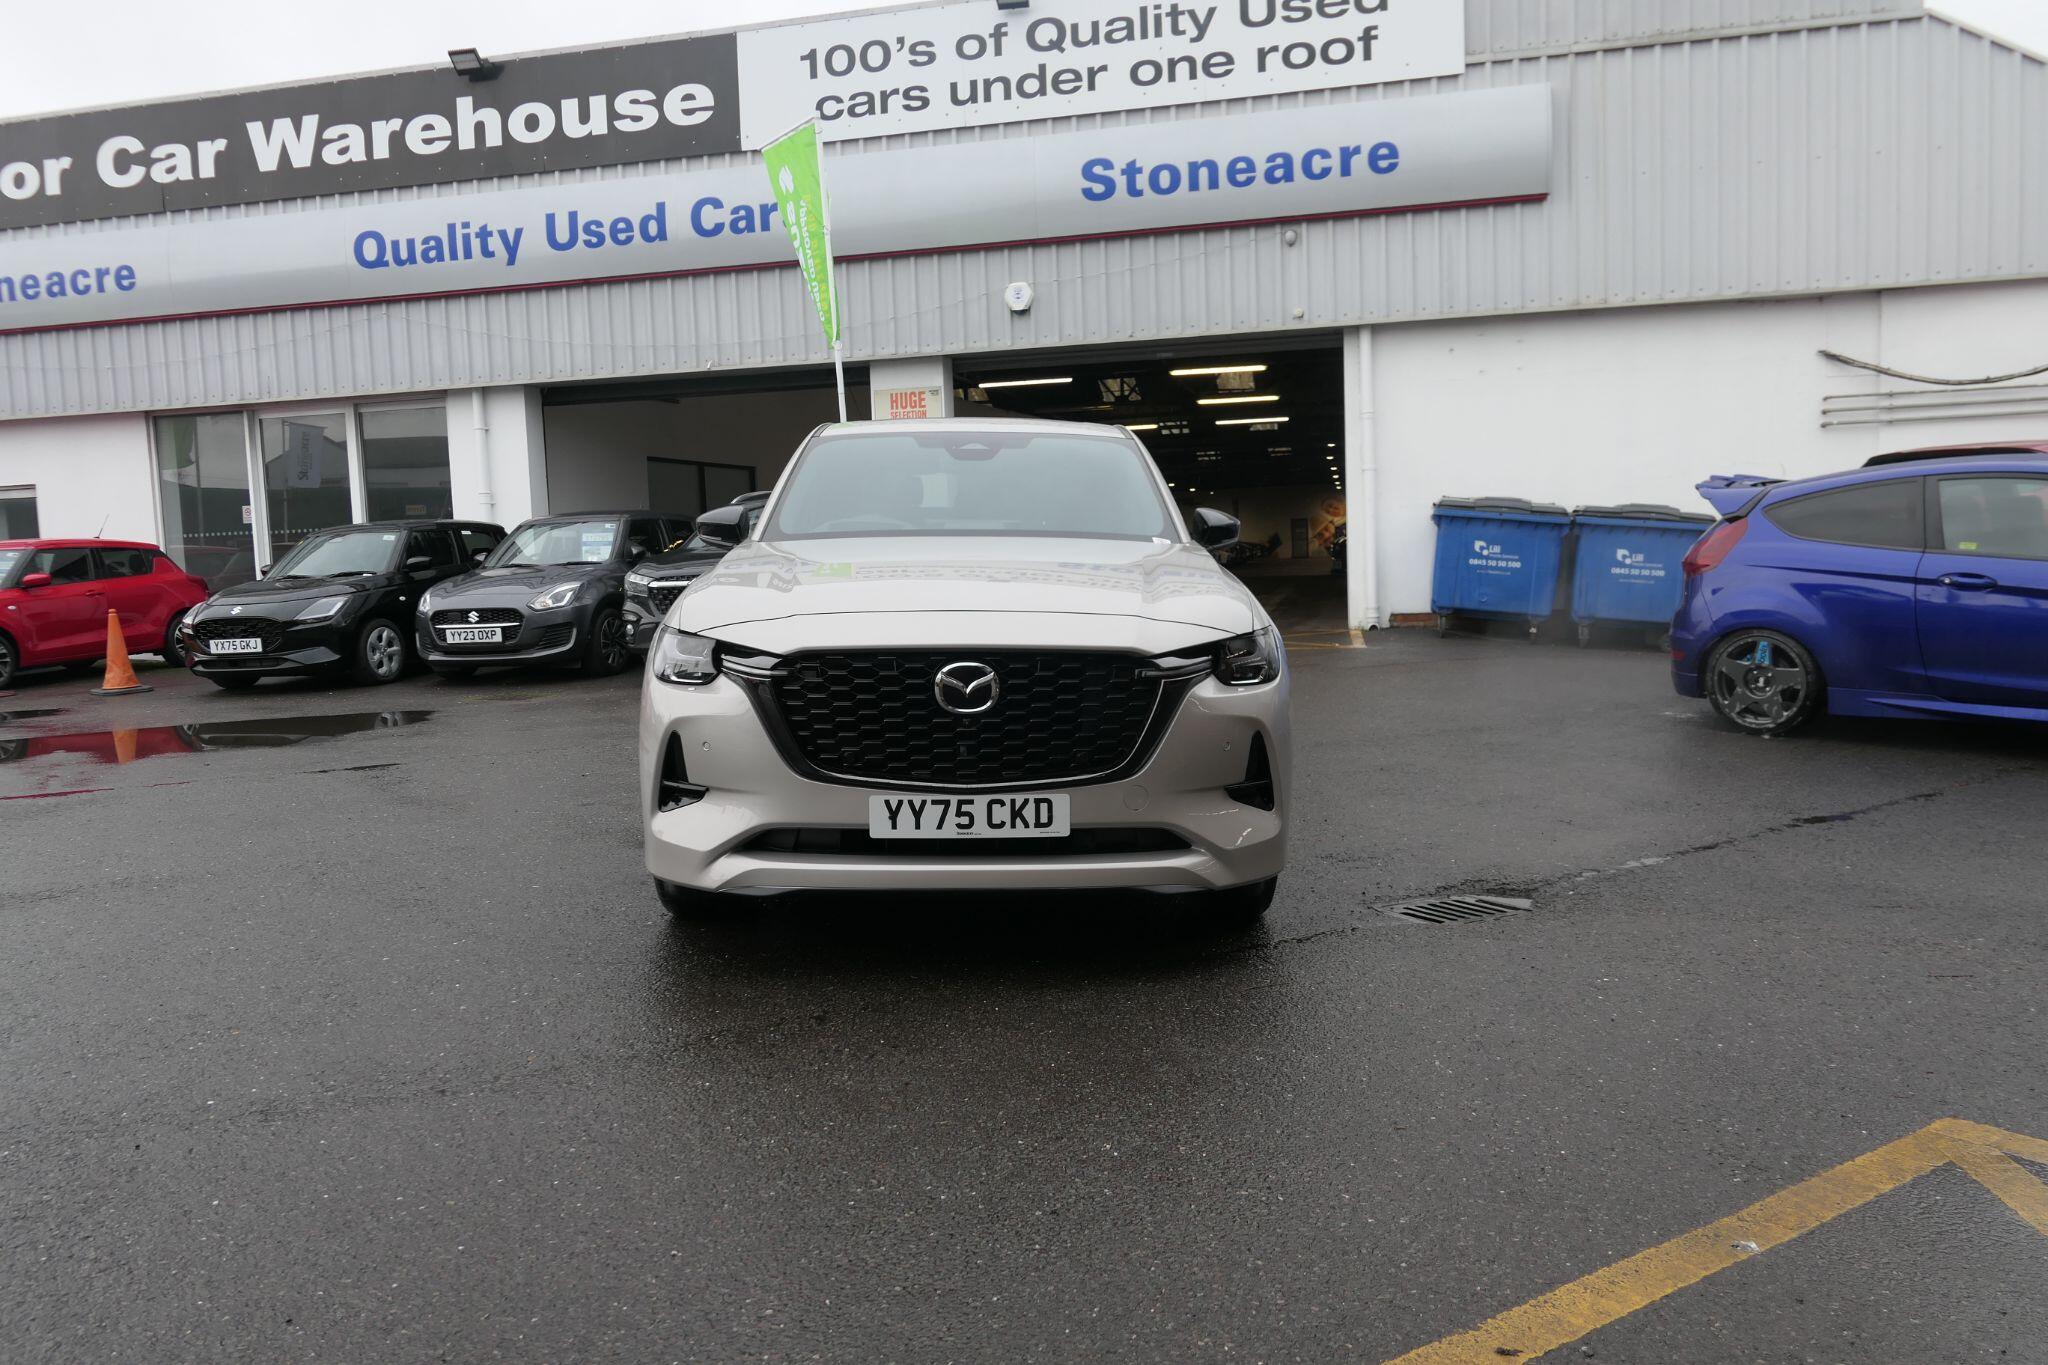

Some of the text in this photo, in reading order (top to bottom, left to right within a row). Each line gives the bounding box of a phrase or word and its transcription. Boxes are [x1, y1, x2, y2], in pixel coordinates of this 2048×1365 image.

[800, 36, 937, 80] 100's
[955, 22, 1008, 61] of
[1025, 3, 1217, 54] Quality
[815, 25, 1379, 121] cars under one roof
[0, 83, 715, 199] or Car Warehouse
[1081, 141, 1400, 202] Stoneacre
[353, 197, 783, 269] Quality Used Car
[889, 390, 927, 410] HUGE
[890, 410, 928, 419] SELECTION
[213, 640, 258, 651] YX75 GKJ
[450, 629, 497, 641] YY23 OXP
[884, 798, 1053, 830] YY75 CKD
